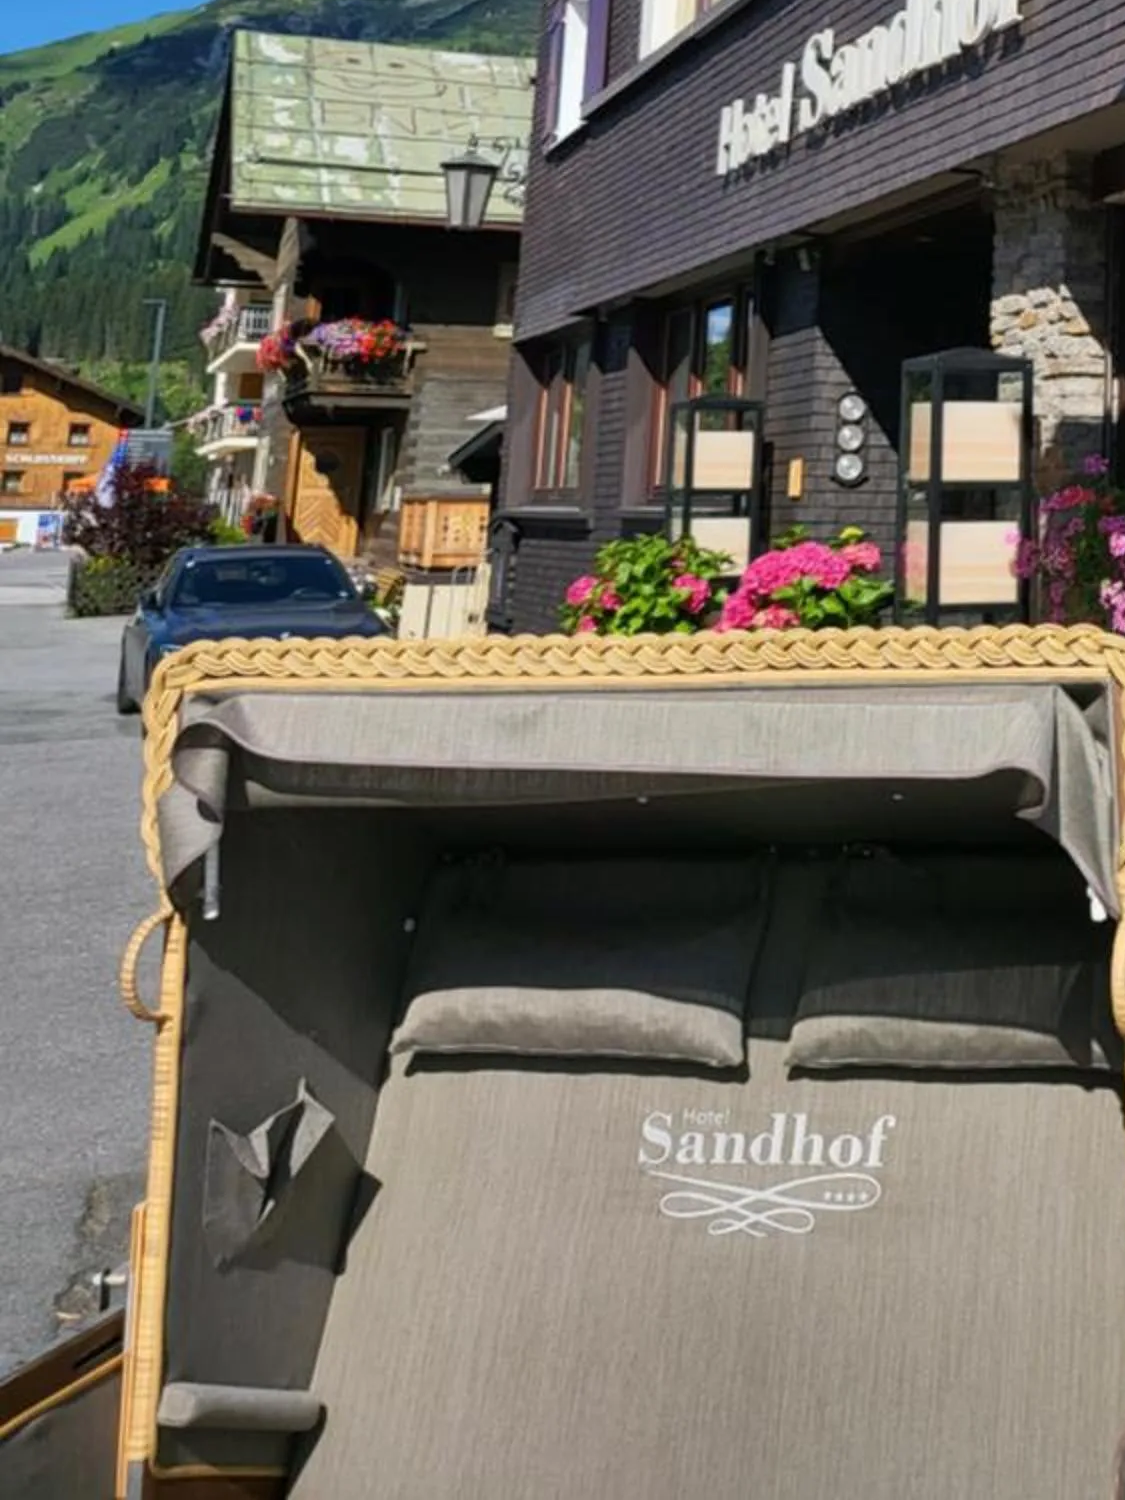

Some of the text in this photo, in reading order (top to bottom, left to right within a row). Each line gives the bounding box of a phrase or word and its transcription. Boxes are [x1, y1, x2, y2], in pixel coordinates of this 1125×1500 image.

[716, 61, 796, 175] Hotel
[638, 1111, 896, 1168] Sandhof
[682, 1107, 731, 1126] Hotel
